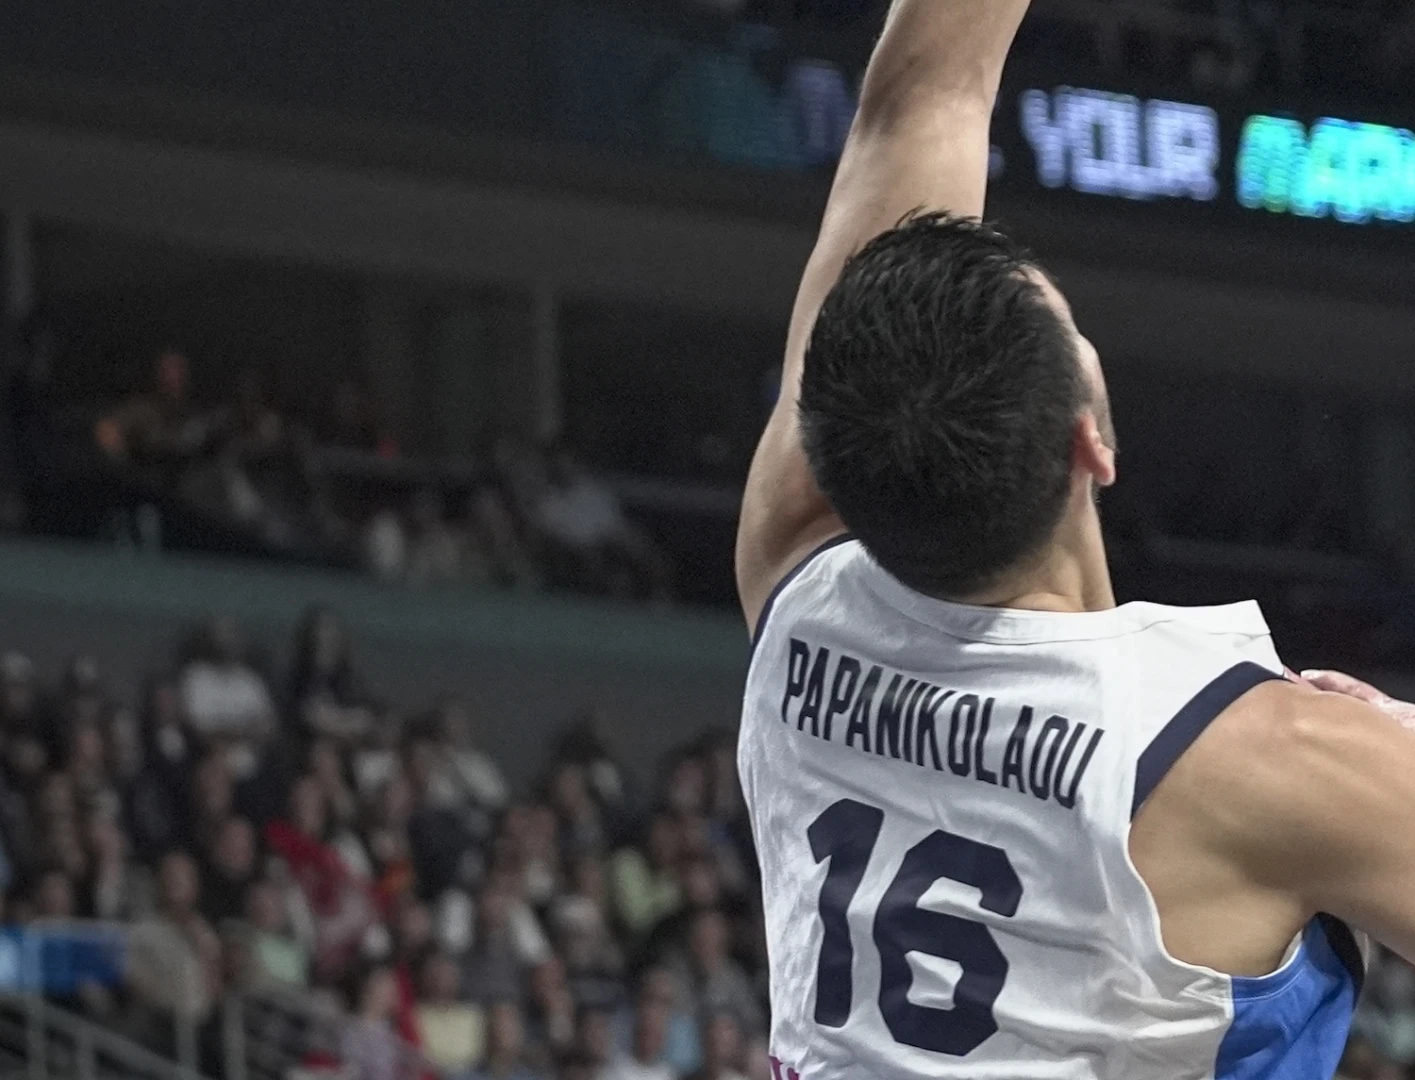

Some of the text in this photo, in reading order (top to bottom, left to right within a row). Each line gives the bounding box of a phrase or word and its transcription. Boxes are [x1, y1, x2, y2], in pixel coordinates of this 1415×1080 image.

[1021, 85, 1220, 202] YOUR
[781, 637, 1106, 809] PAPANIKOLAOU
[806, 797, 1024, 1056] 16
